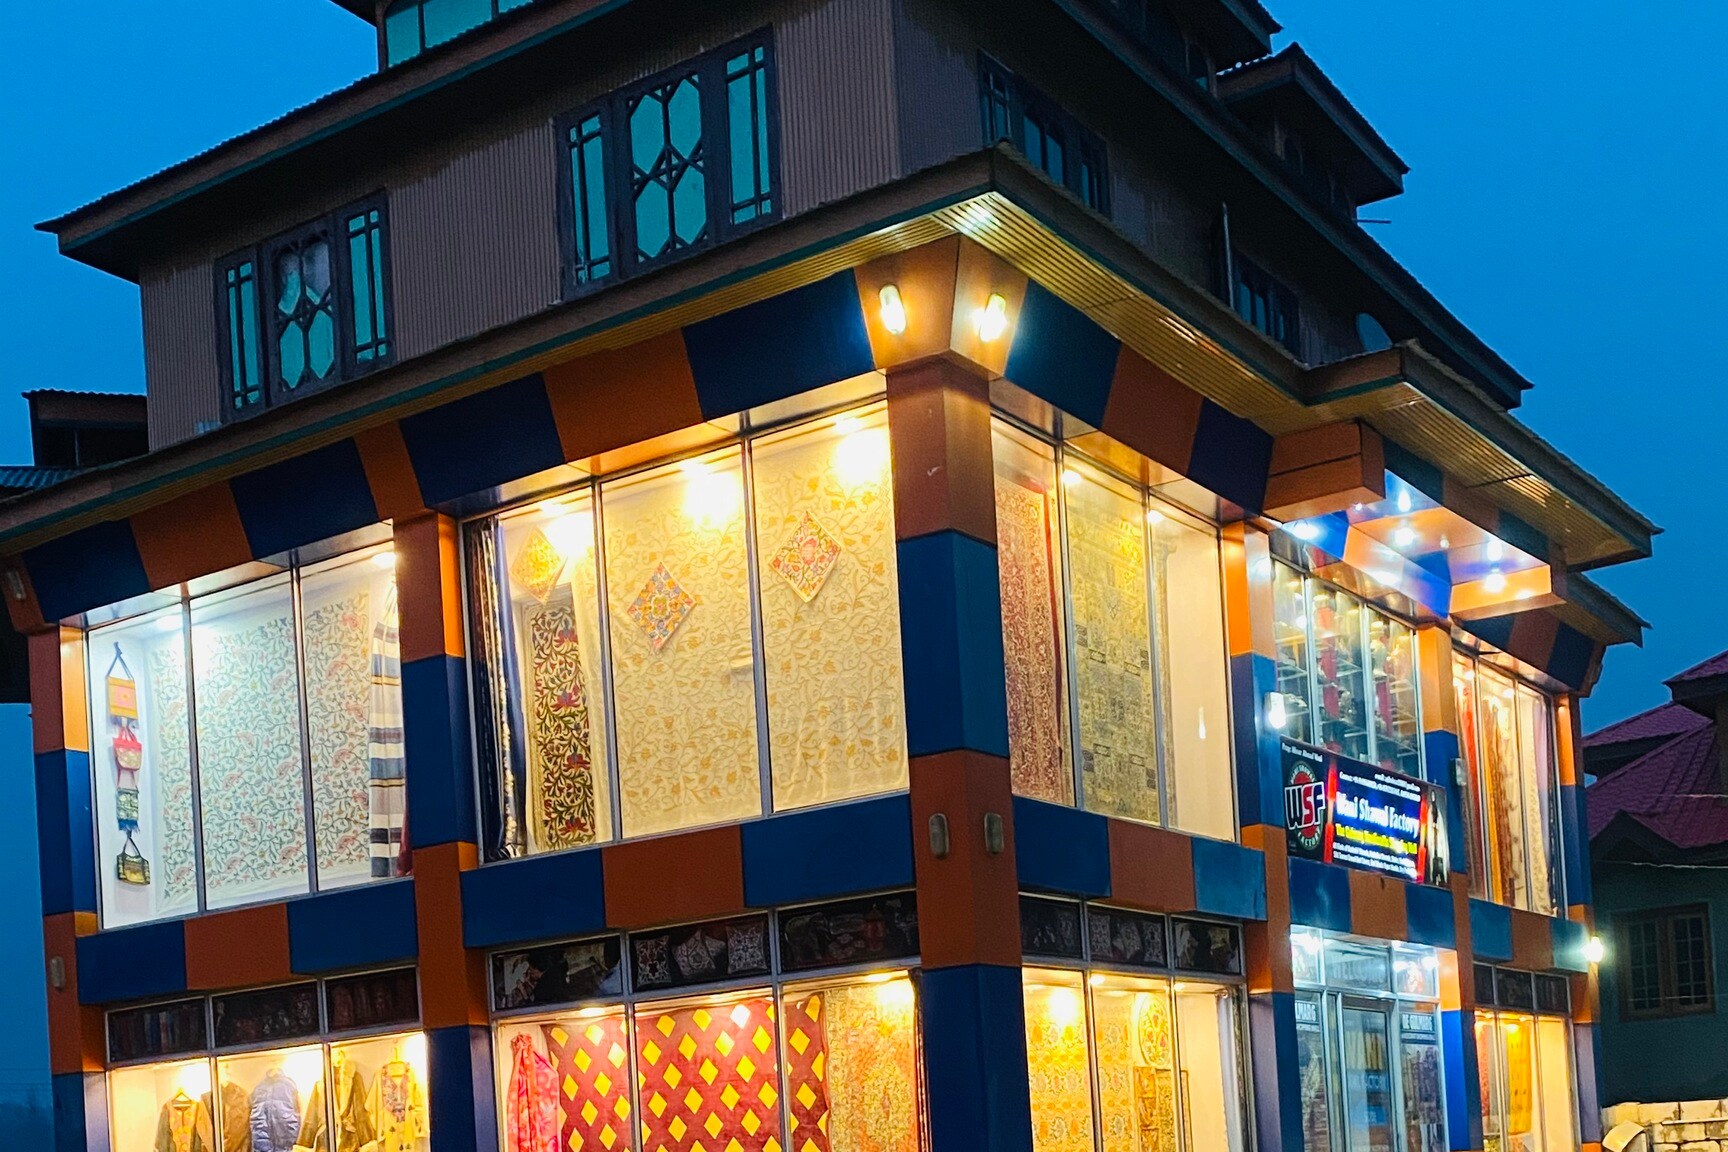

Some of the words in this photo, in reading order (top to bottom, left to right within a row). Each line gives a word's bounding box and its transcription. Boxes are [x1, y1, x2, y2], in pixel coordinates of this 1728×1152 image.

[1284, 781, 1326, 830] WSF
[1359, 798, 1389, 828] Shawl
[1389, 806, 1420, 838] Factory
